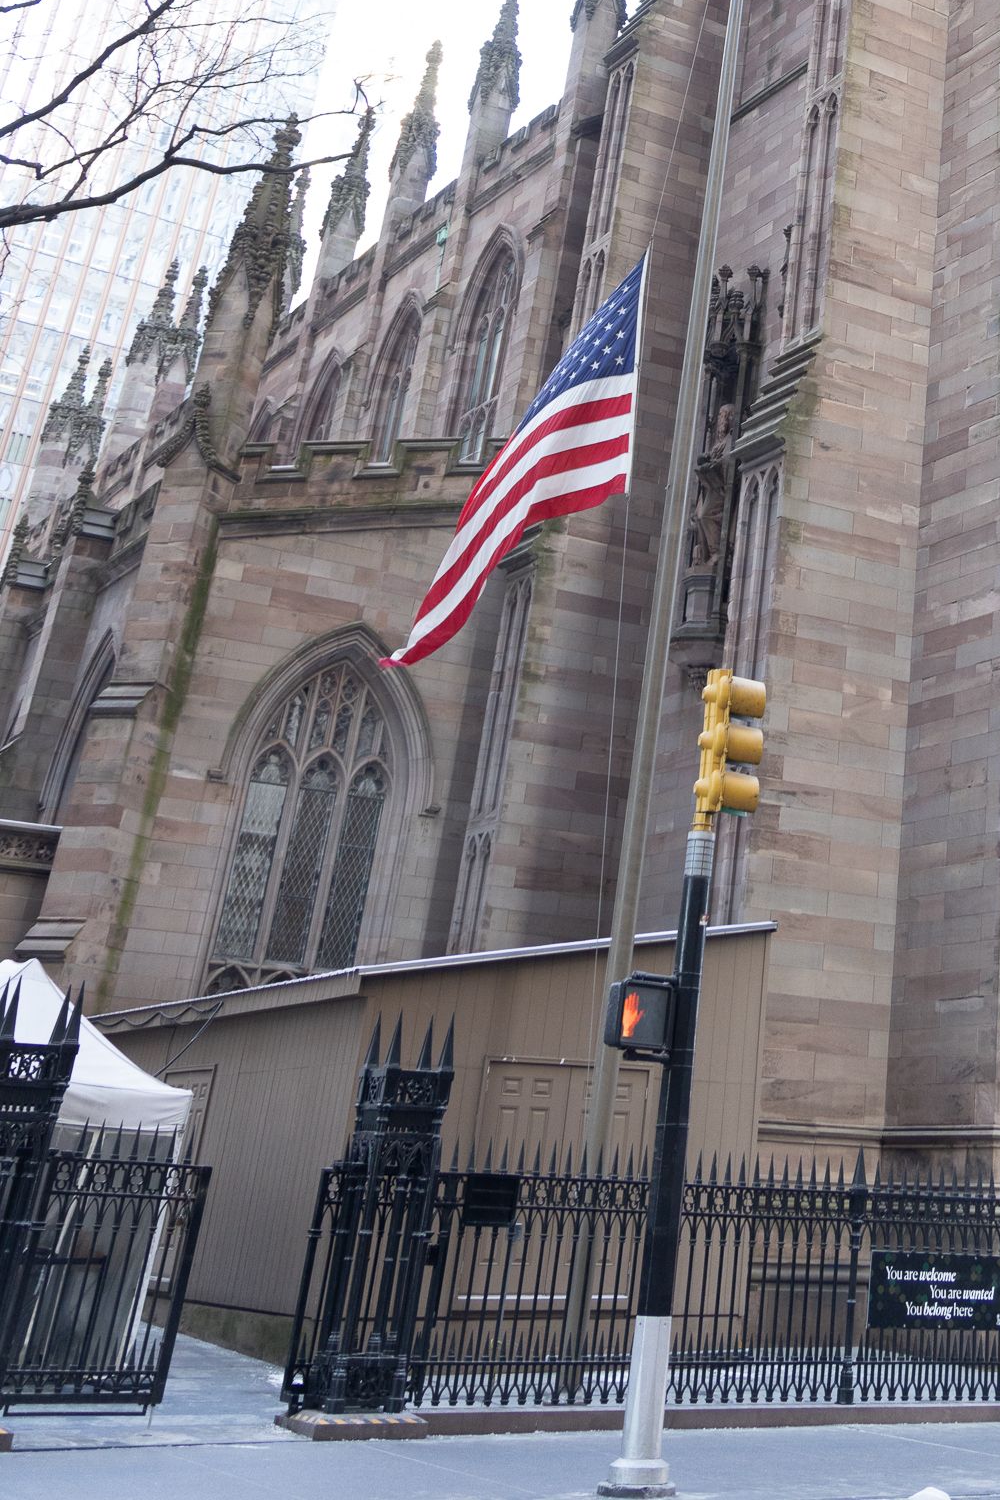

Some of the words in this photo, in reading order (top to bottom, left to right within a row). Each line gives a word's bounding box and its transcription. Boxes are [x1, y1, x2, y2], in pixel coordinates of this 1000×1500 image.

[886, 1266, 902, 1280] You
[904, 1271, 919, 1280] are
[919, 1267, 956, 1282] welcome
[930, 1285, 947, 1299] You
[948, 1290, 962, 1299] are
[962, 1286, 995, 1300] wanted
[906, 1301, 922, 1316] You
[923, 1302, 953, 1320] belong
[954, 1303, 973, 1317] here
